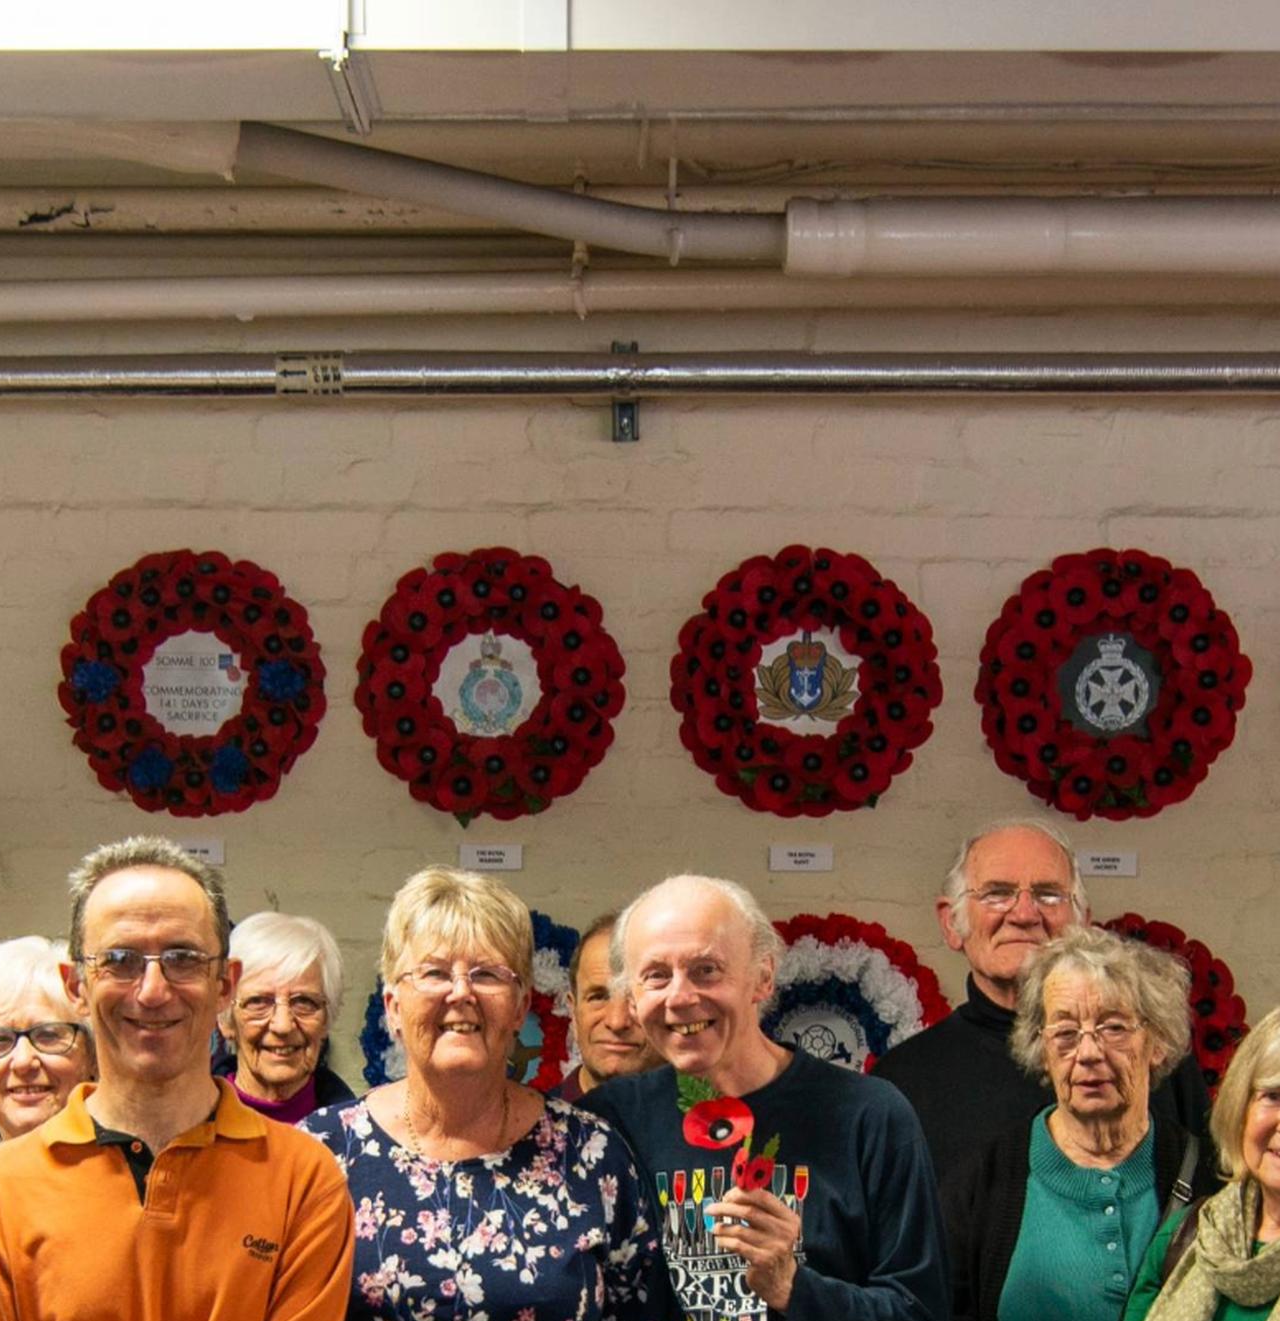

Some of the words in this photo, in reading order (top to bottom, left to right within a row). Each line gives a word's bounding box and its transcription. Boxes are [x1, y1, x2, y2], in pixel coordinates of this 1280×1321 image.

[156, 656, 193, 666] SOMME
[182, 700, 209, 709] DAYS
[668, 1265, 757, 1299] OXFO
